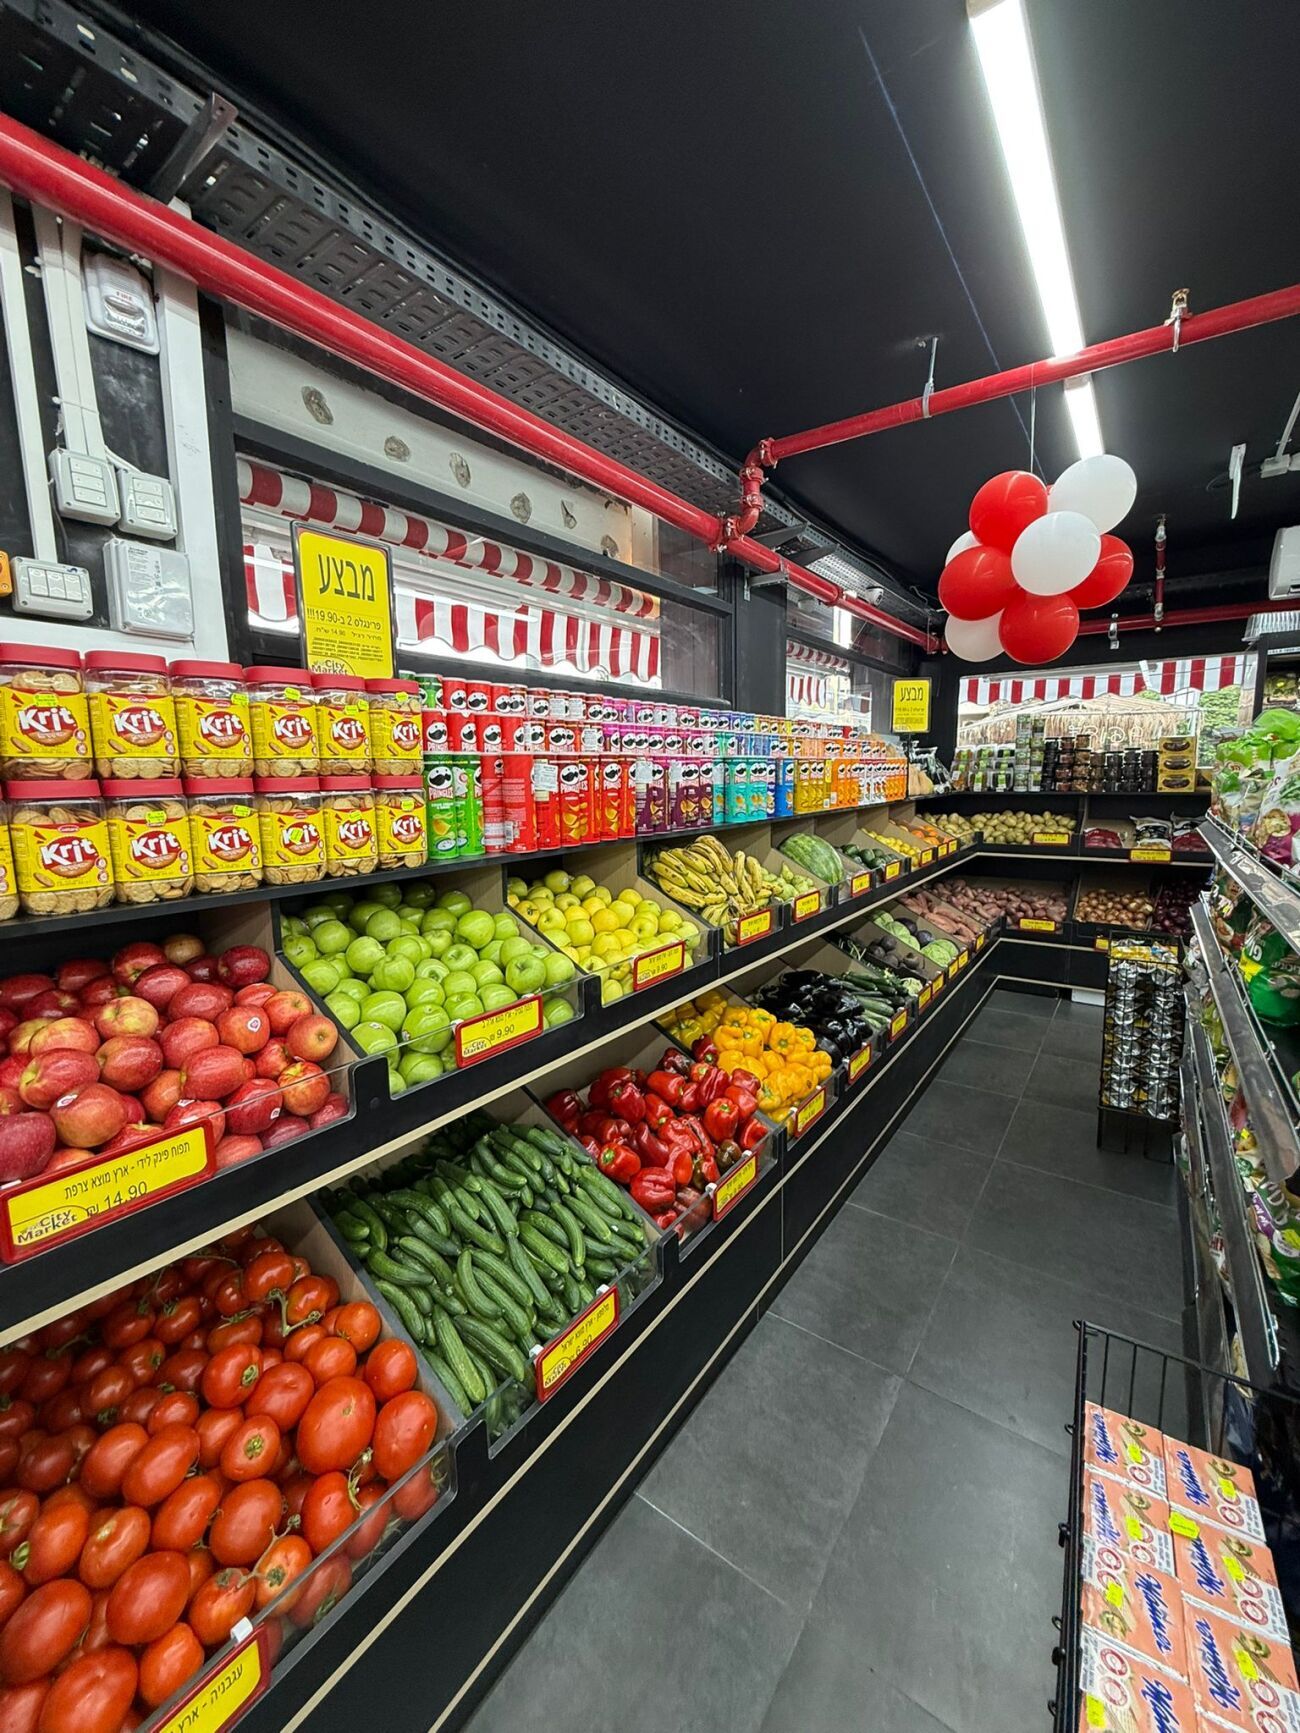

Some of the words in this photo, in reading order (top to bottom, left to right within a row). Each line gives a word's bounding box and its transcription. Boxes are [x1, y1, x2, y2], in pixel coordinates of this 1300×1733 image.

[317, 554, 375, 602] מבצע
[354, 616, 382, 631] פרינגלס
[311, 664, 348, 675] Market
[325, 659, 345, 670] City
[900, 687, 924, 702] מבצע
[18, 707, 76, 733] Krit
[113, 709, 164, 734] Krit
[200, 714, 243, 737] Krit
[274, 717, 311, 738] Krit
[332, 720, 364, 740] Krit
[393, 722, 420, 742] Krit
[338, 820, 370, 840] Krit
[392, 817, 421, 836] Krit
[131, 832, 179, 858] Krit
[208, 828, 250, 851] Krit
[41, 838, 96, 866] Krit
[496, 1023, 515, 1039] 9.90
[152, 1149, 169, 1167] פינק
[171, 1141, 190, 1158] תפוח
[136, 1154, 151, 1170] לידי
[91, 1171, 111, 1188] מוצא
[113, 1164, 129, 1182] ארץ
[64, 1179, 89, 1200] צרפת
[103, 1181, 149, 1211] 14.90
[17, 1213, 78, 1244] Market
[38, 1209, 72, 1229] City
[1092, 1412, 1119, 1466] Manner
[1176, 1449, 1211, 1507] Manner
[1091, 1480, 1121, 1548] Manner
[1135, 1571, 1173, 1657] Manner
[1193, 1616, 1243, 1713] Manner
[209, 1663, 243, 1705] עגבניה
